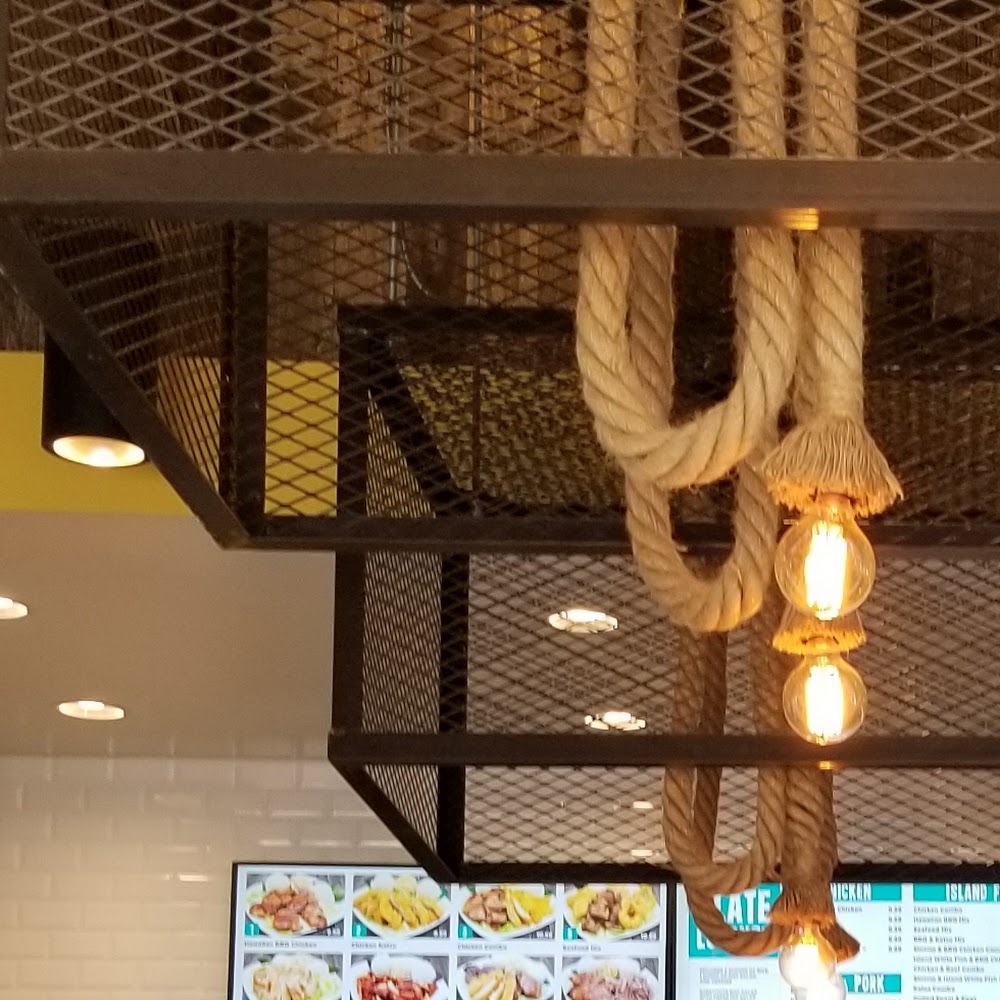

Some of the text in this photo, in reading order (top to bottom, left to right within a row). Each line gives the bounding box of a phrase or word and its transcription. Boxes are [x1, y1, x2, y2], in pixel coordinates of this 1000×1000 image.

[831, 884, 872, 901] HICKEN
[946, 884, 988, 902] ISLAND
[714, 888, 773, 927] LATE
[854, 975, 884, 993] PORK
